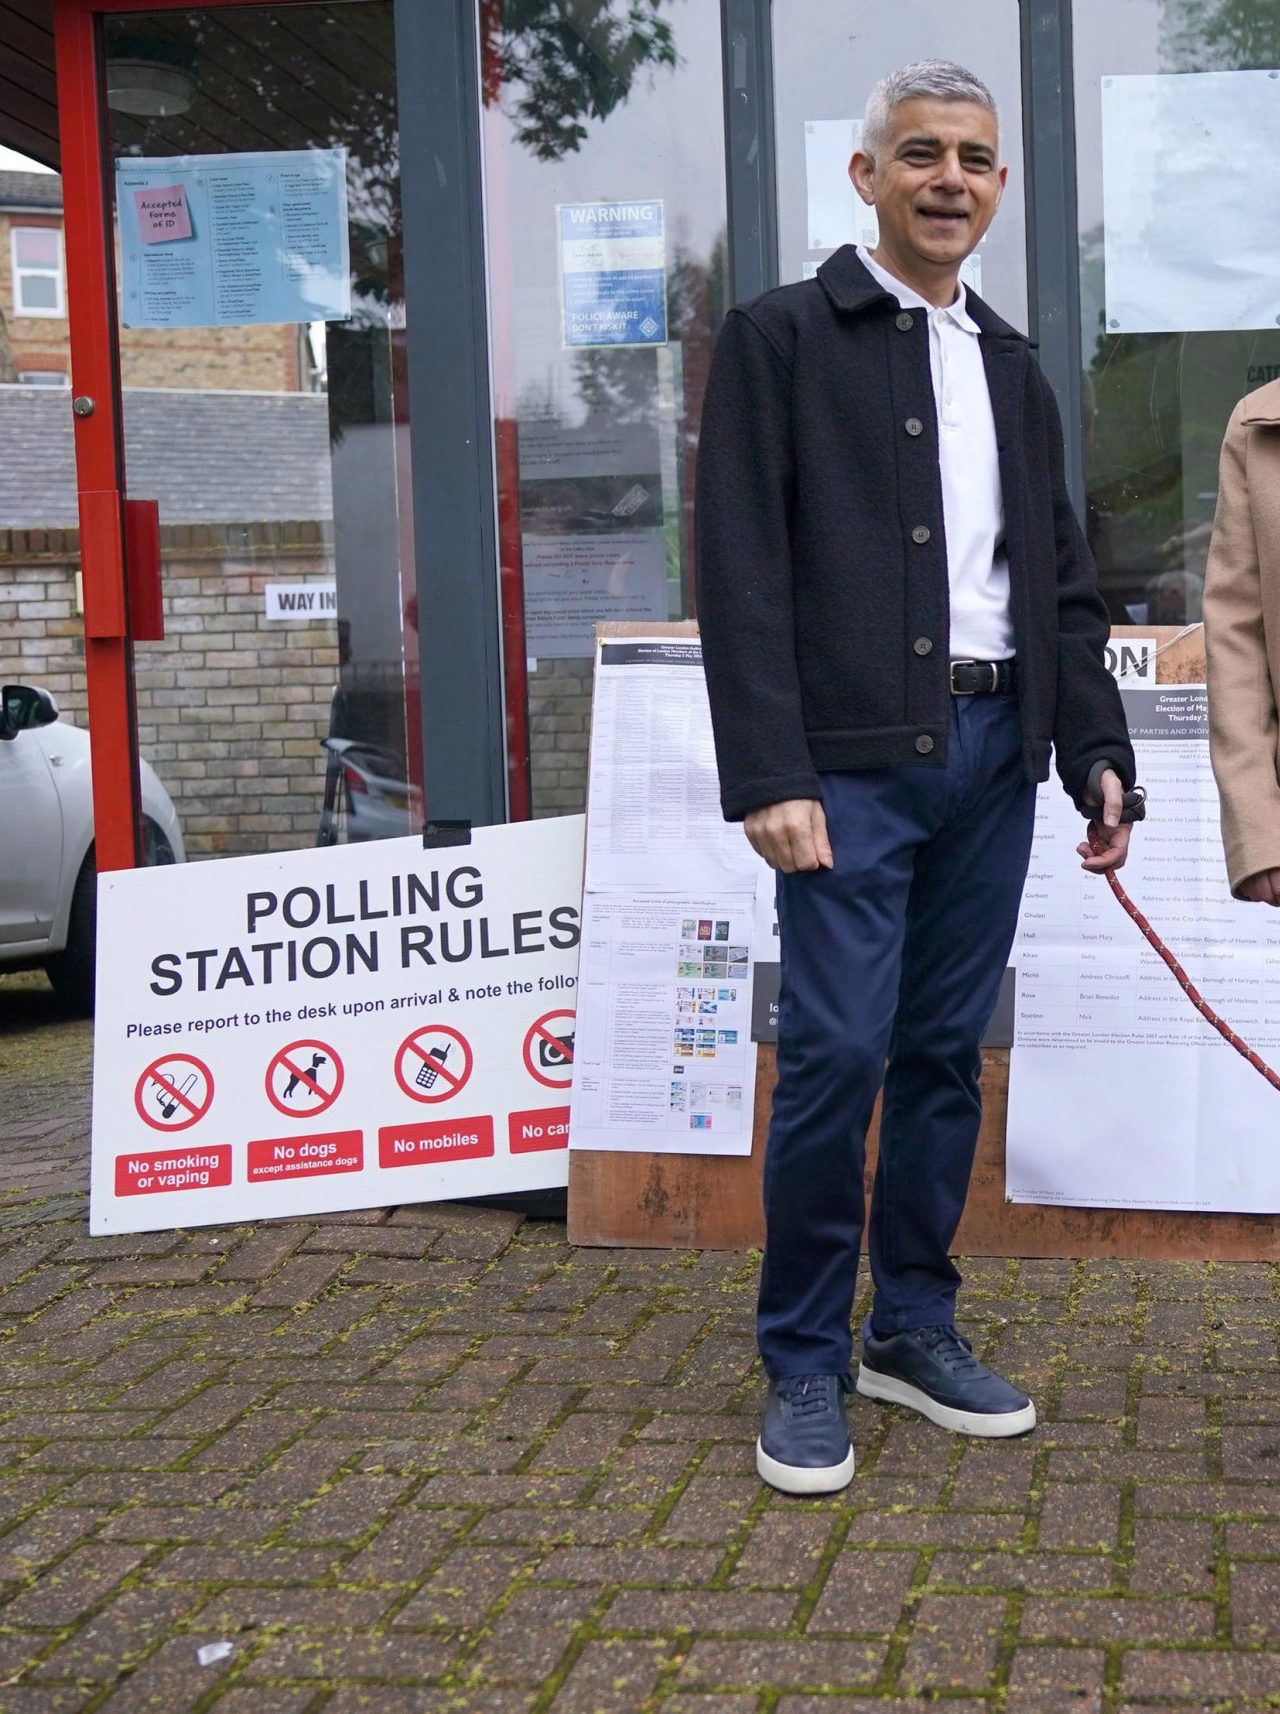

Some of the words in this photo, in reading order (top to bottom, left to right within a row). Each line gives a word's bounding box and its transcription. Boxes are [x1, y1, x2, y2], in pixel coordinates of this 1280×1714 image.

[141, 198, 182, 210] Accepted
[165, 220, 175, 228] ID
[570, 206, 652, 224] WARNING
[572, 312, 605, 322] POLICE
[607, 311, 639, 320] AWARE
[572, 323, 599, 332] DON'T
[600, 323, 618, 331] RISK
[278, 592, 314, 610] WAY
[320, 592, 336, 610] IN
[1168, 714, 1201, 722] Thursday
[247, 866, 484, 933] POLLING
[150, 932, 379, 996] STATION
[400, 906, 580, 968] RULES
[126, 1022, 182, 1038] Please
[188, 1013, 239, 1033] report
[244, 1012, 260, 1025] to
[265, 1008, 292, 1023] the
[297, 1003, 337, 1020] desk
[342, 999, 384, 1017] upon
[390, 990, 442, 1009] arrival
[448, 988, 460, 1002] &
[465, 985, 501, 1000] note
[507, 980, 533, 995] the
[1179, 1016, 1194, 1024] Royal
[522, 1125, 543, 1139] No
[274, 1146, 295, 1159] No
[299, 1141, 336, 1159] dogs
[394, 1139, 415, 1153] No
[419, 1134, 479, 1150] mobiles
[128, 1160, 149, 1174] No
[153, 1154, 220, 1172] smoking
[253, 1164, 283, 1175] except
[285, 1158, 333, 1170] assistance
[335, 1156, 358, 1166] dogs
[137, 1175, 152, 1188] or
[158, 1170, 209, 1187] vaping
